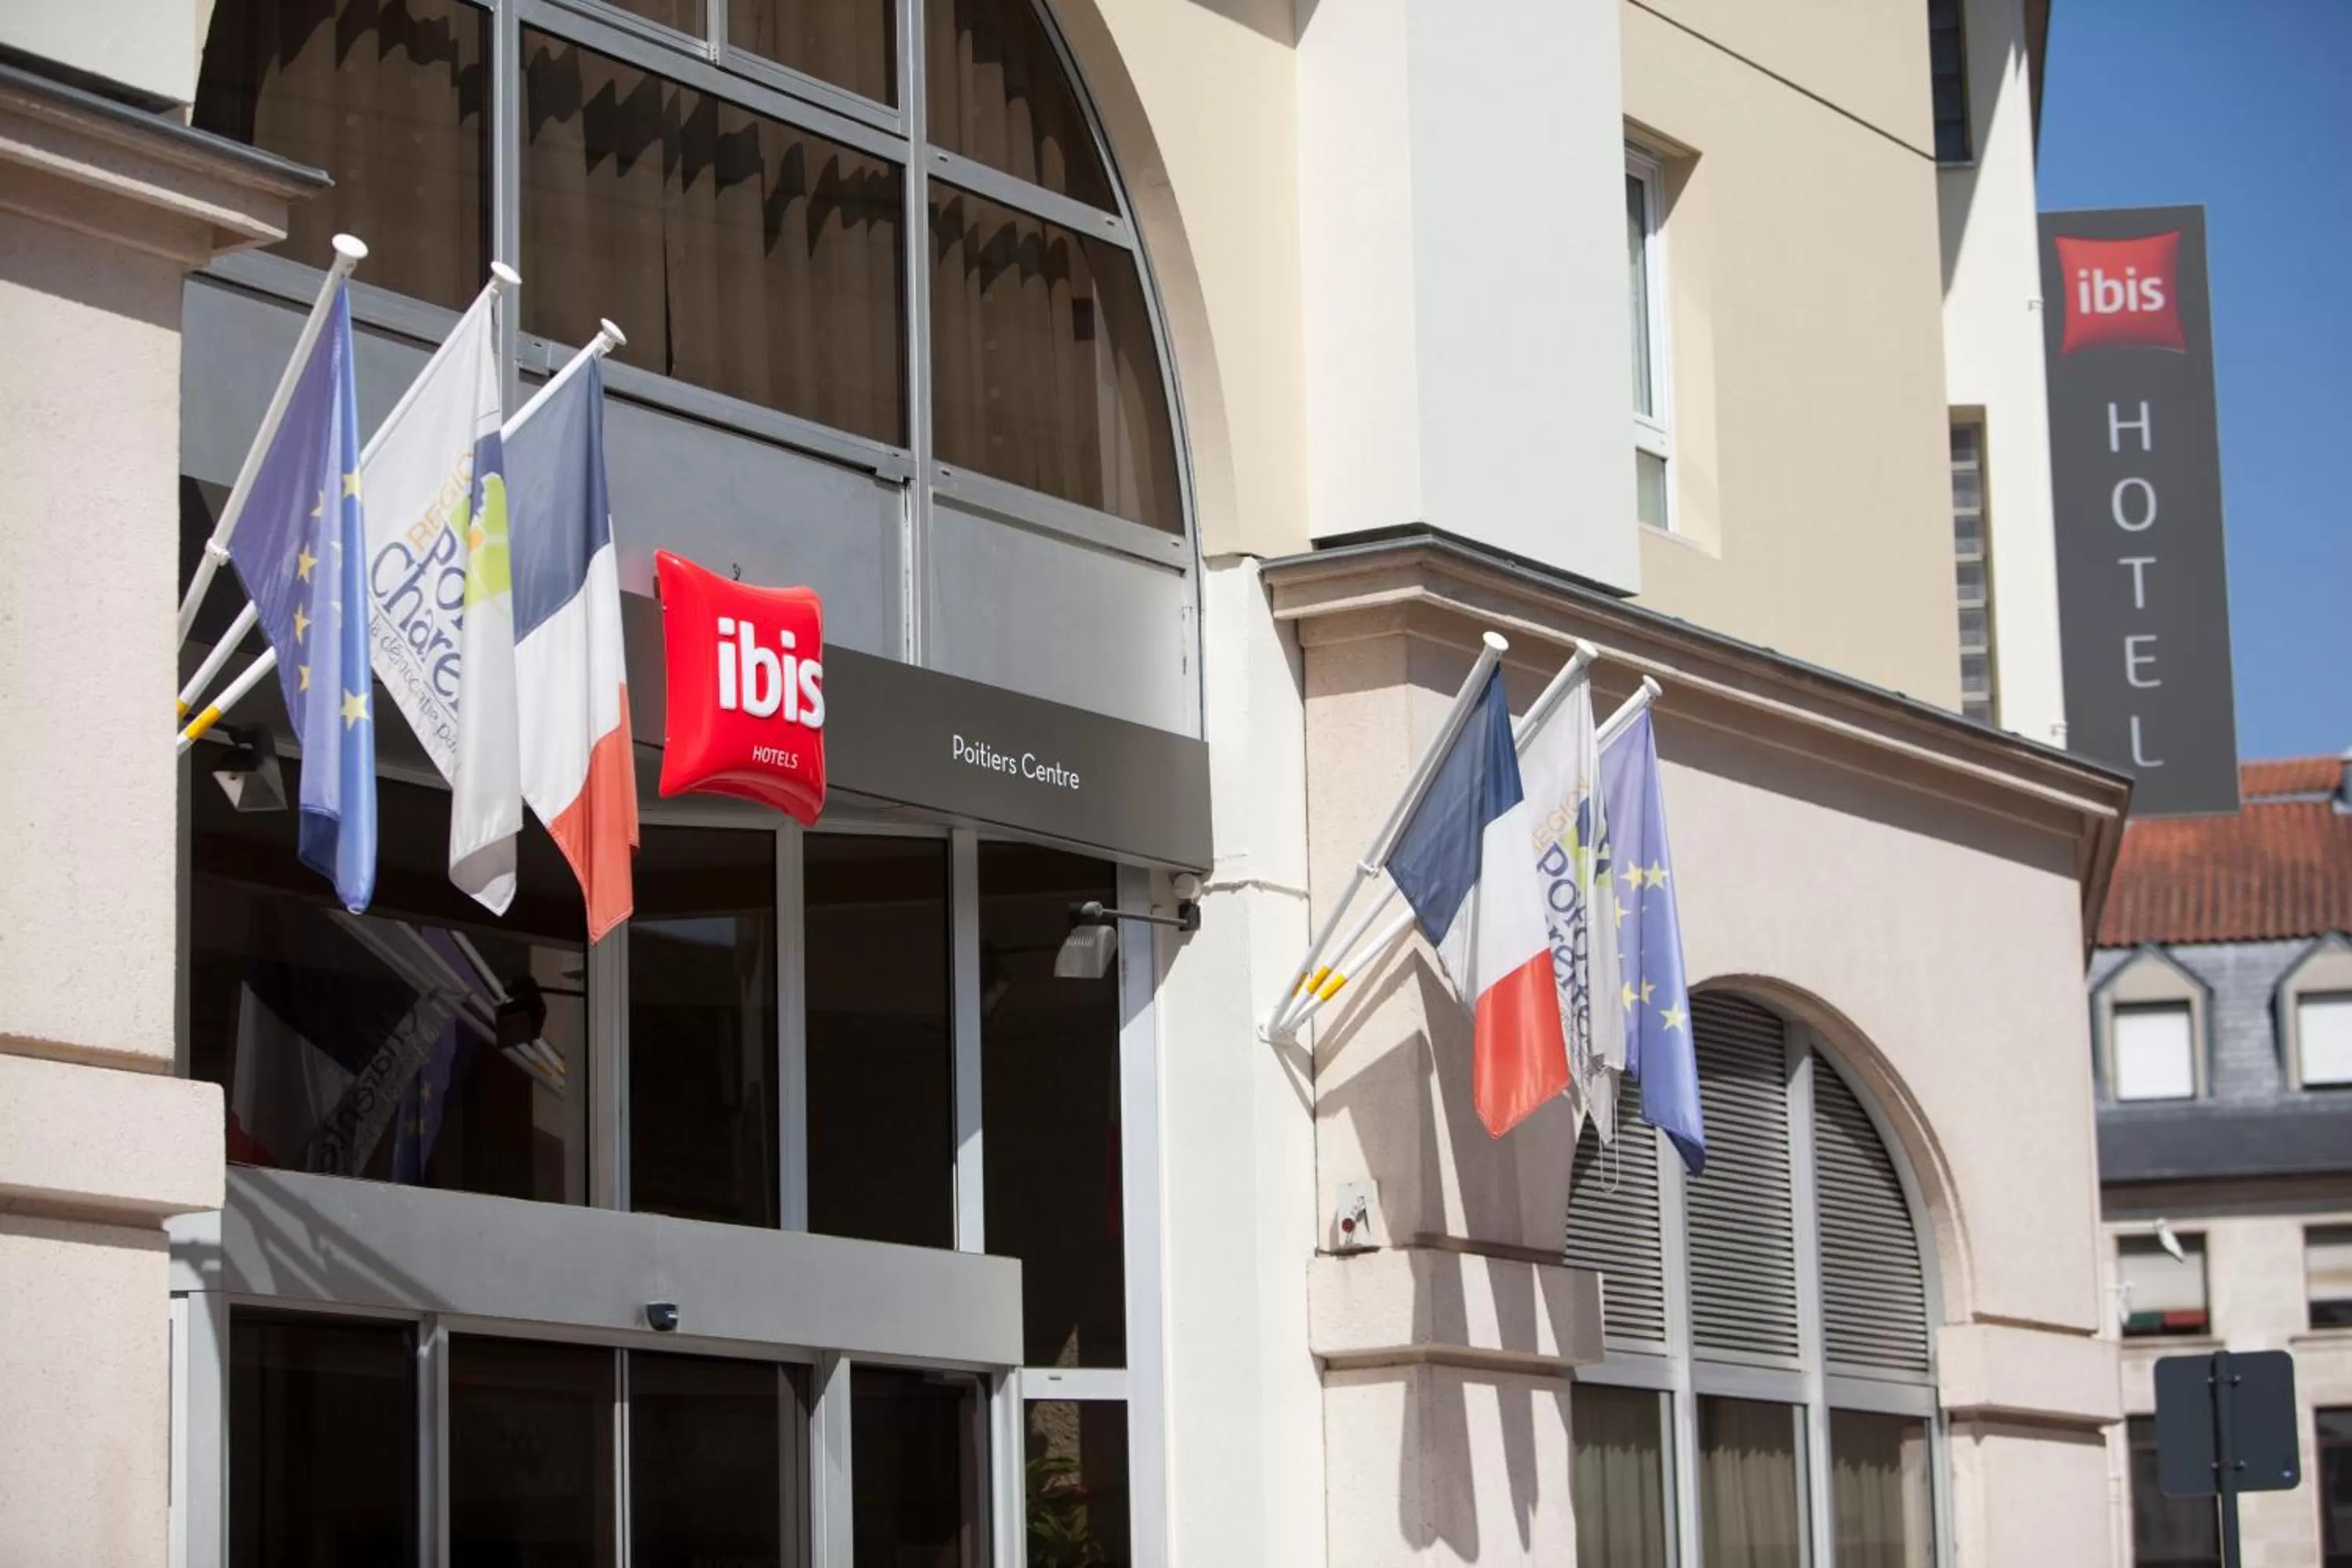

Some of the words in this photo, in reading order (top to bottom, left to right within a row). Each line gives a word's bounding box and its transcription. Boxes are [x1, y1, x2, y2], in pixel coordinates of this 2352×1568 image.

[2078, 266, 2165, 314] ibis
[2107, 401, 2164, 768] HOTEL
[371, 541, 461, 713] Chare
[717, 616, 826, 728] ibis
[752, 746, 799, 769] HOTELS
[953, 734, 1017, 775] Poitiers
[1022, 753, 1080, 789] Centre
